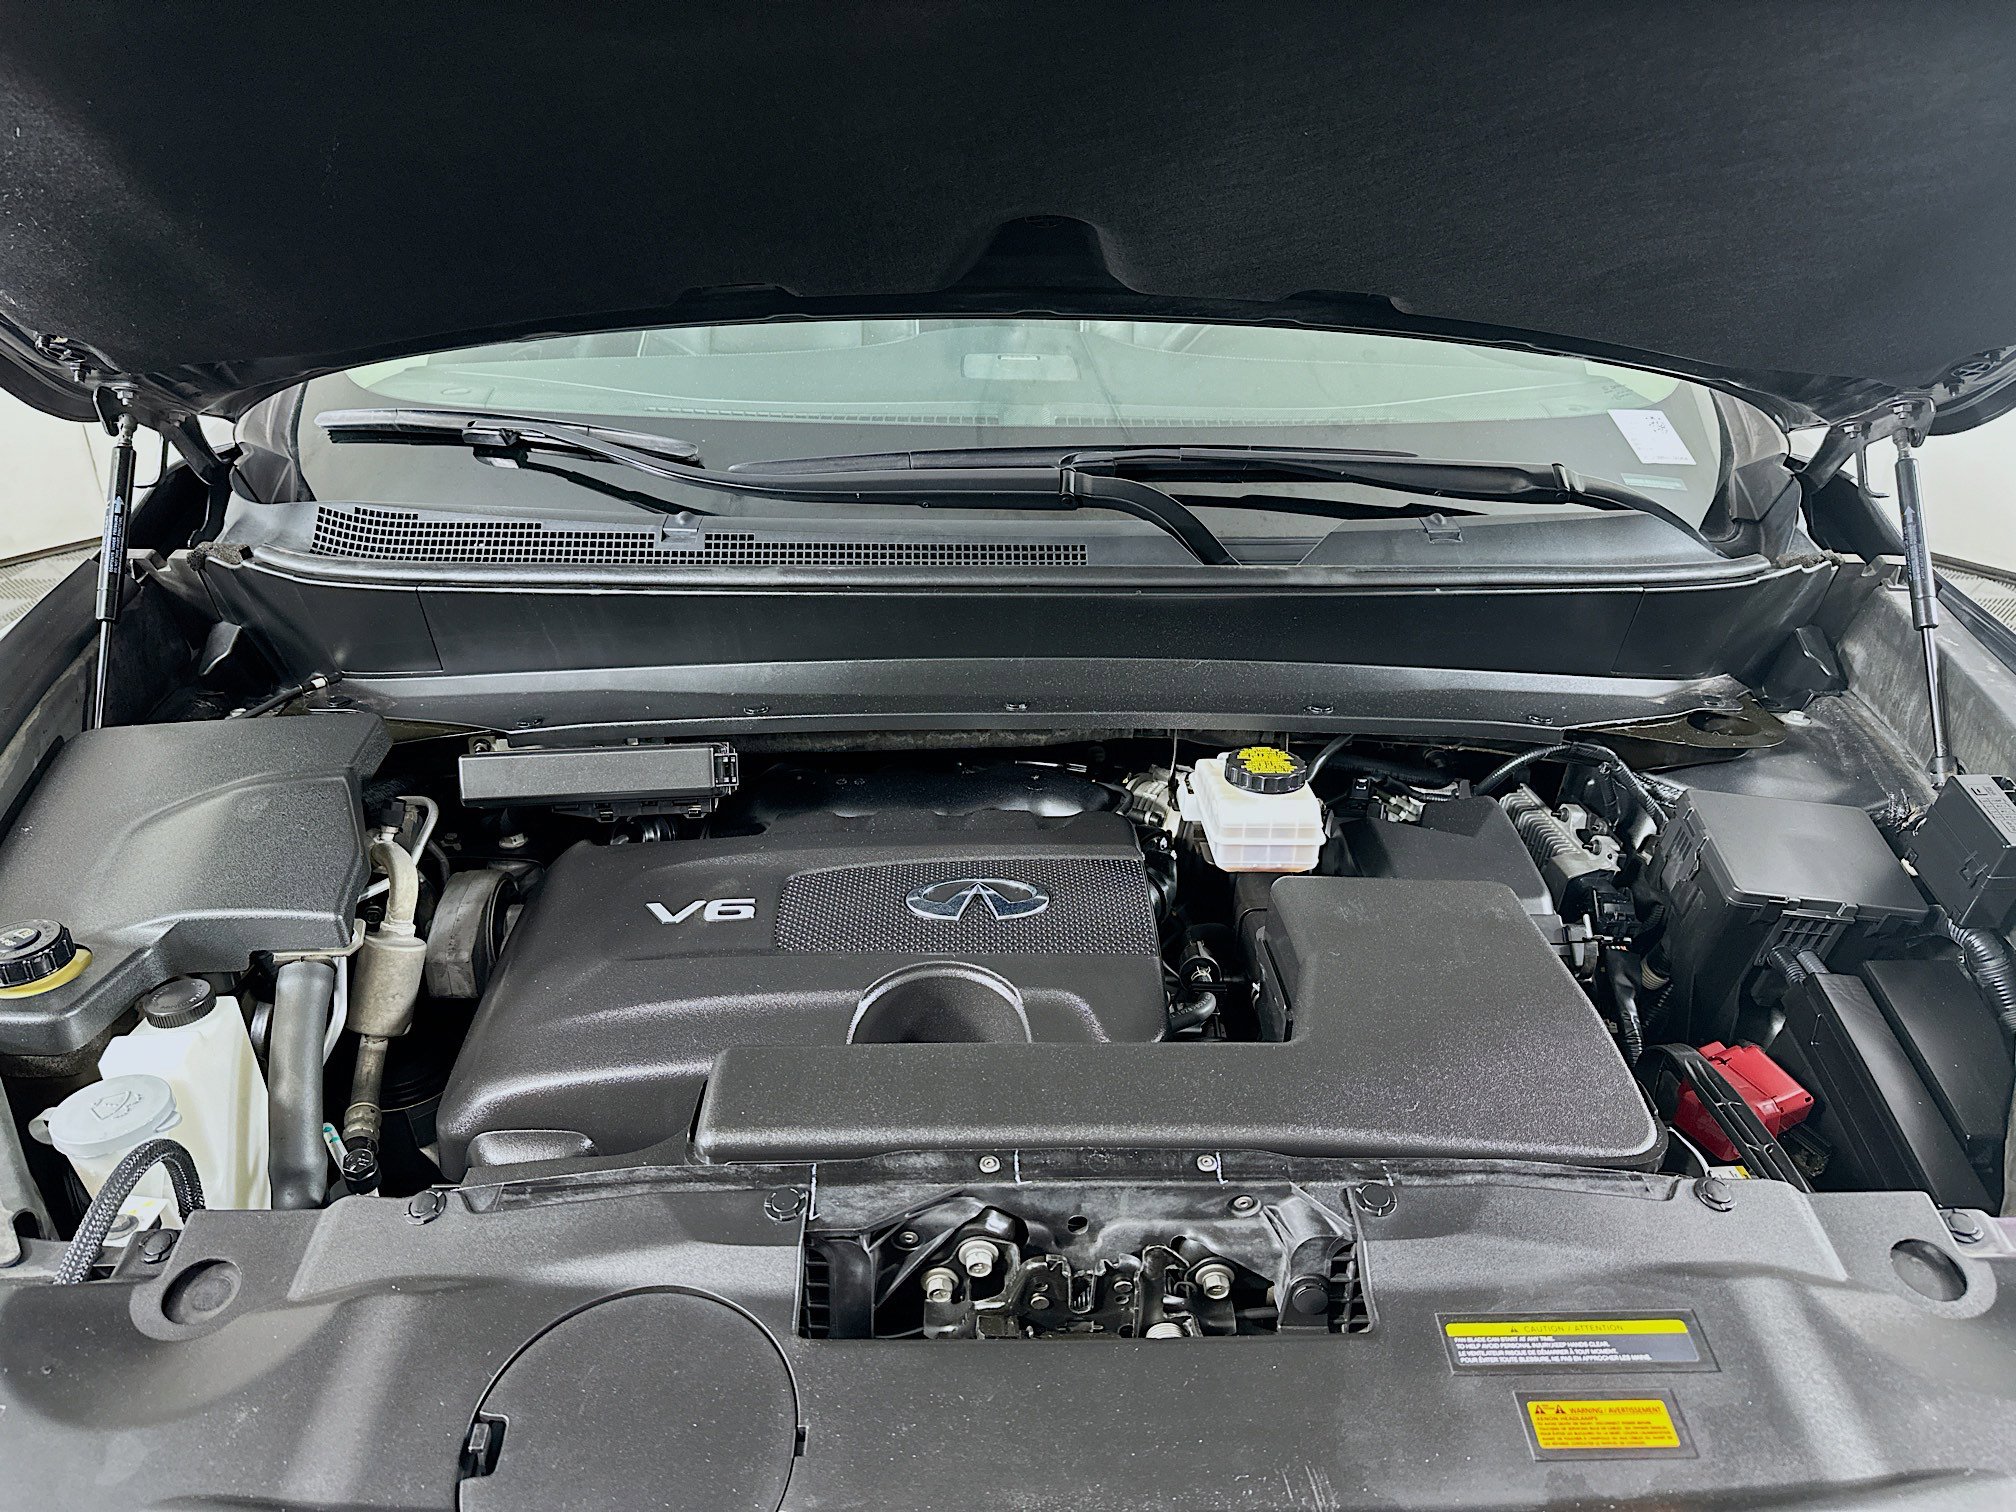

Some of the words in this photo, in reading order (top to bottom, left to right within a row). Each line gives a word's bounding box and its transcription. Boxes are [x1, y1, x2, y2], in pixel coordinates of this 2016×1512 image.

[645, 898, 756, 924] V6
[1523, 1325, 1564, 1333] CAUTION
[1574, 1324, 1624, 1332] ATTENTION
